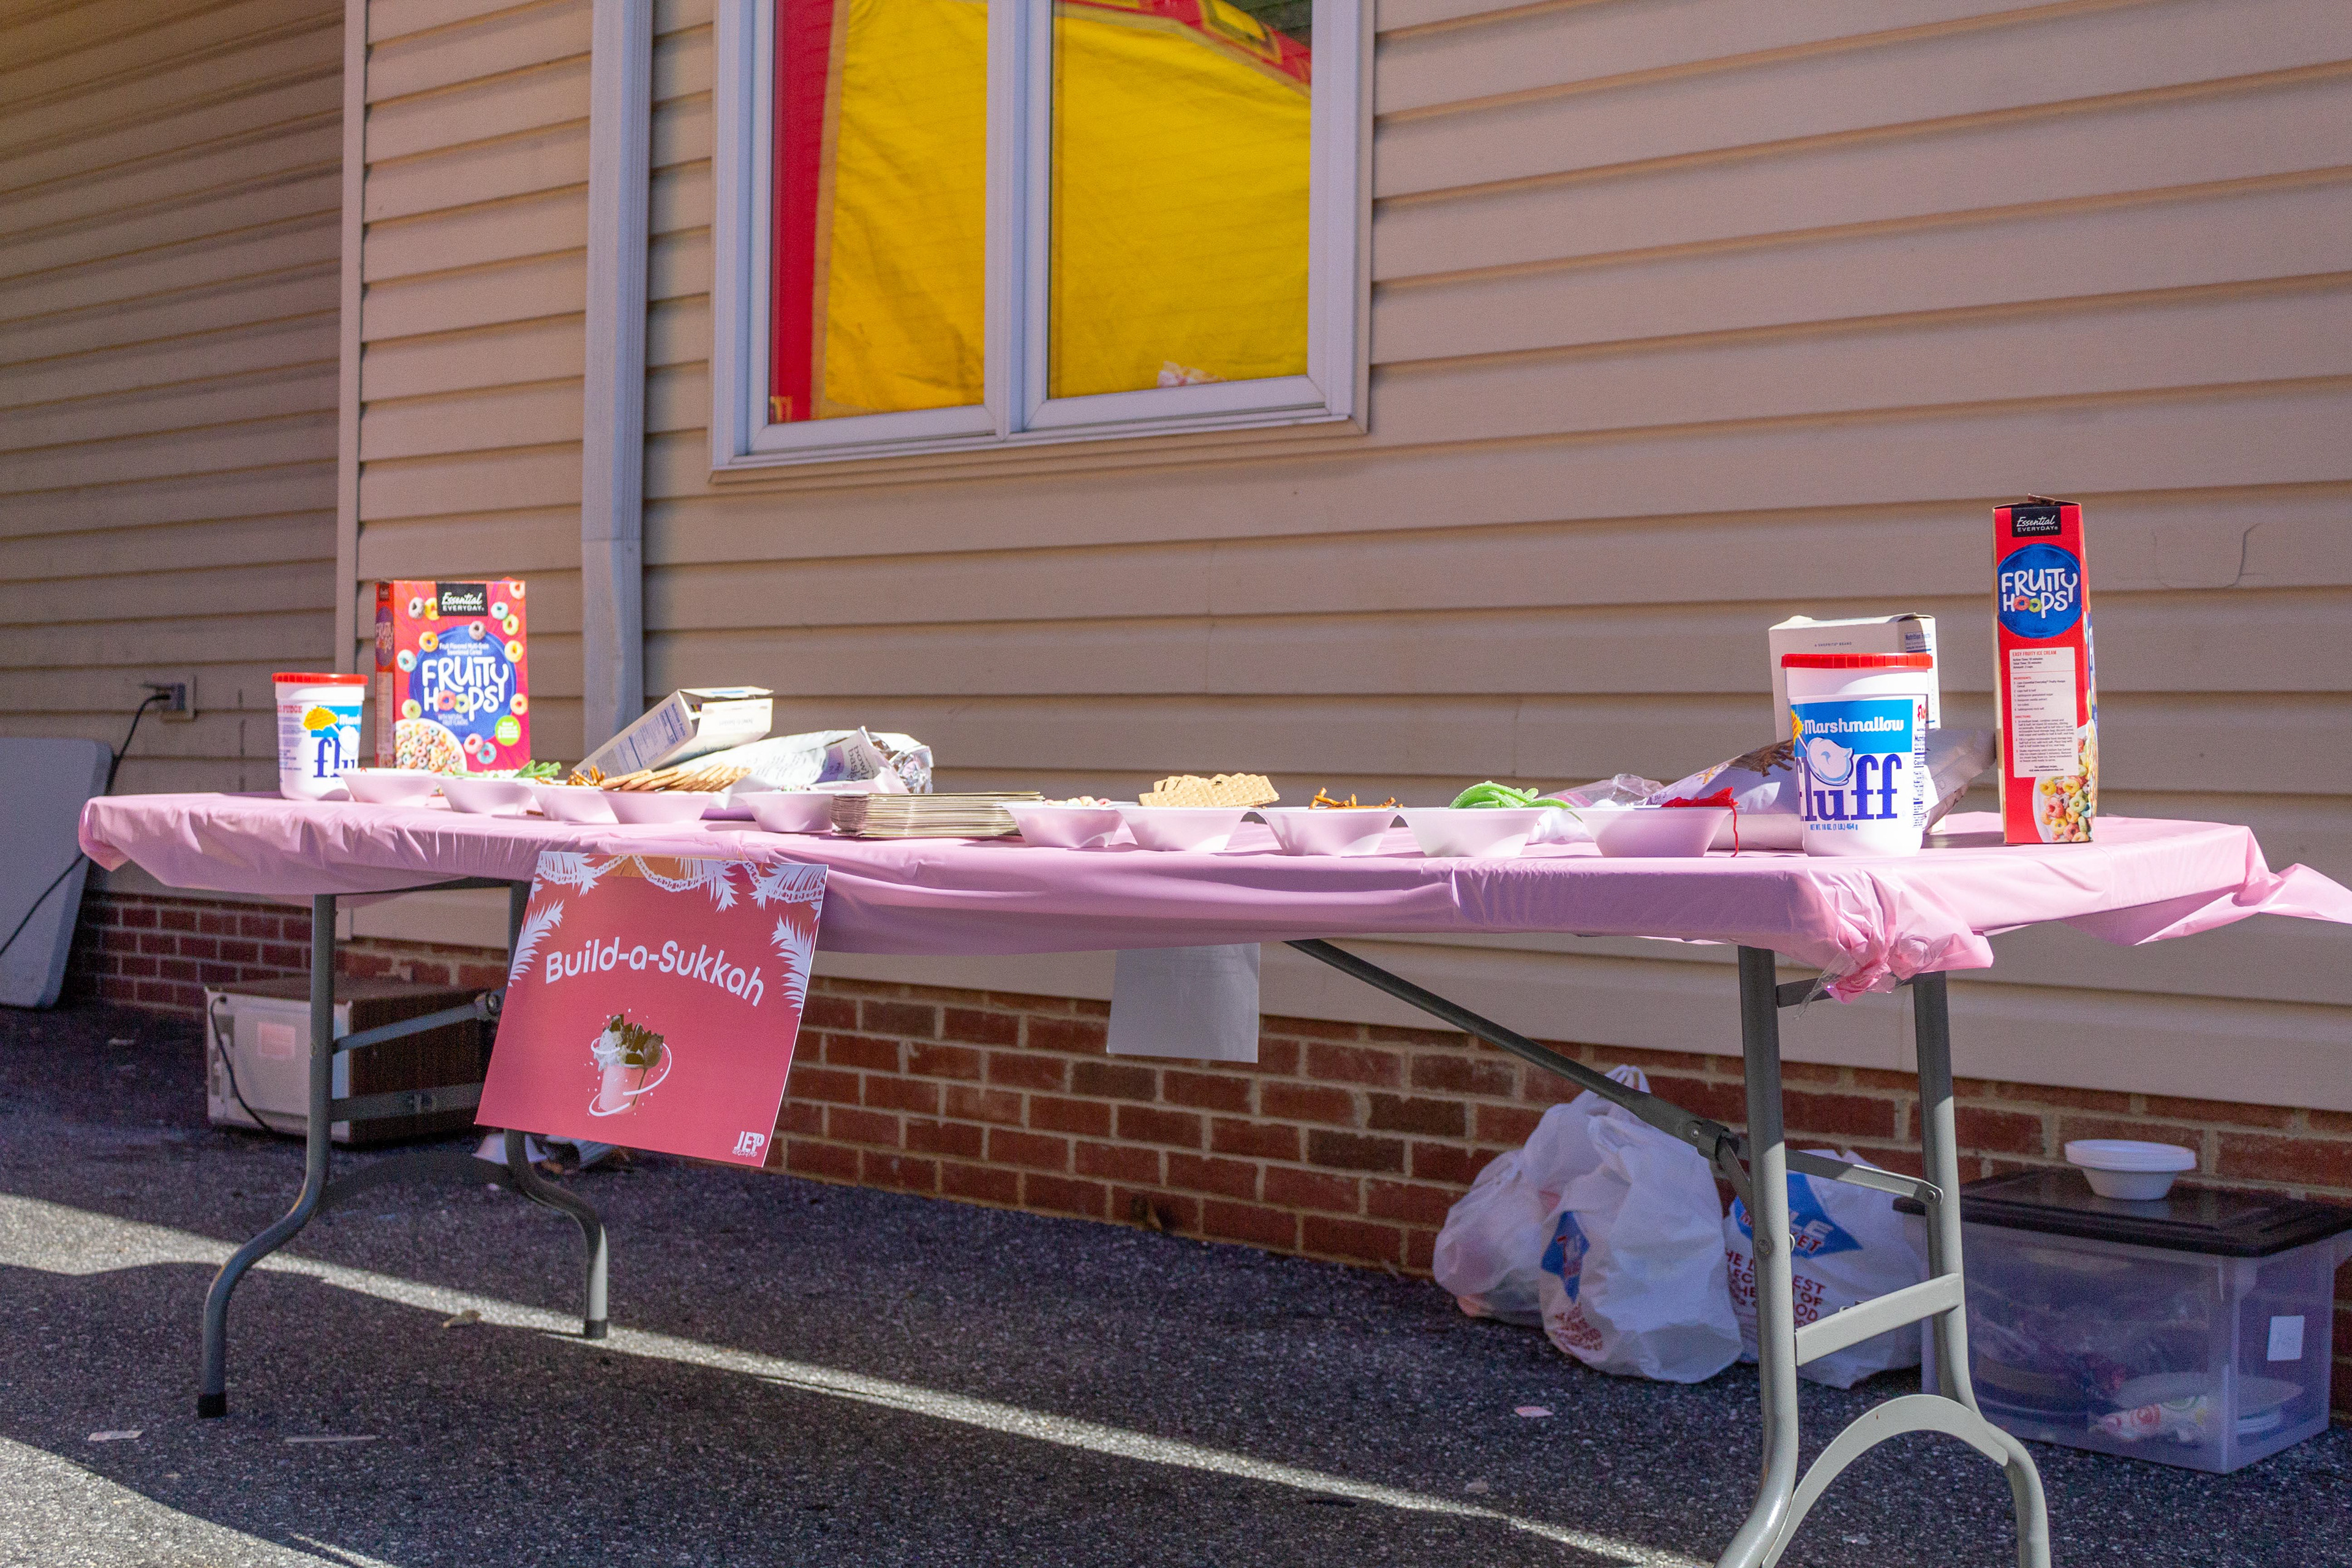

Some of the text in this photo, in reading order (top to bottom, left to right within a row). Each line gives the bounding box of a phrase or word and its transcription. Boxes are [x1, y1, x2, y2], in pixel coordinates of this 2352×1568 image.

[2016, 515, 2056, 527] Essential
[442, 592, 483, 605] Essential
[2001, 568, 2078, 603] FRUITY
[2003, 590, 2068, 619] HOOPS
[422, 656, 510, 702] FRUITY
[424, 685, 499, 722] HOOPS
[1804, 716, 1904, 734] Marshmallow
[546, 937, 764, 1007] Build-a-Sukkah
[734, 1131, 764, 1153] JEP
